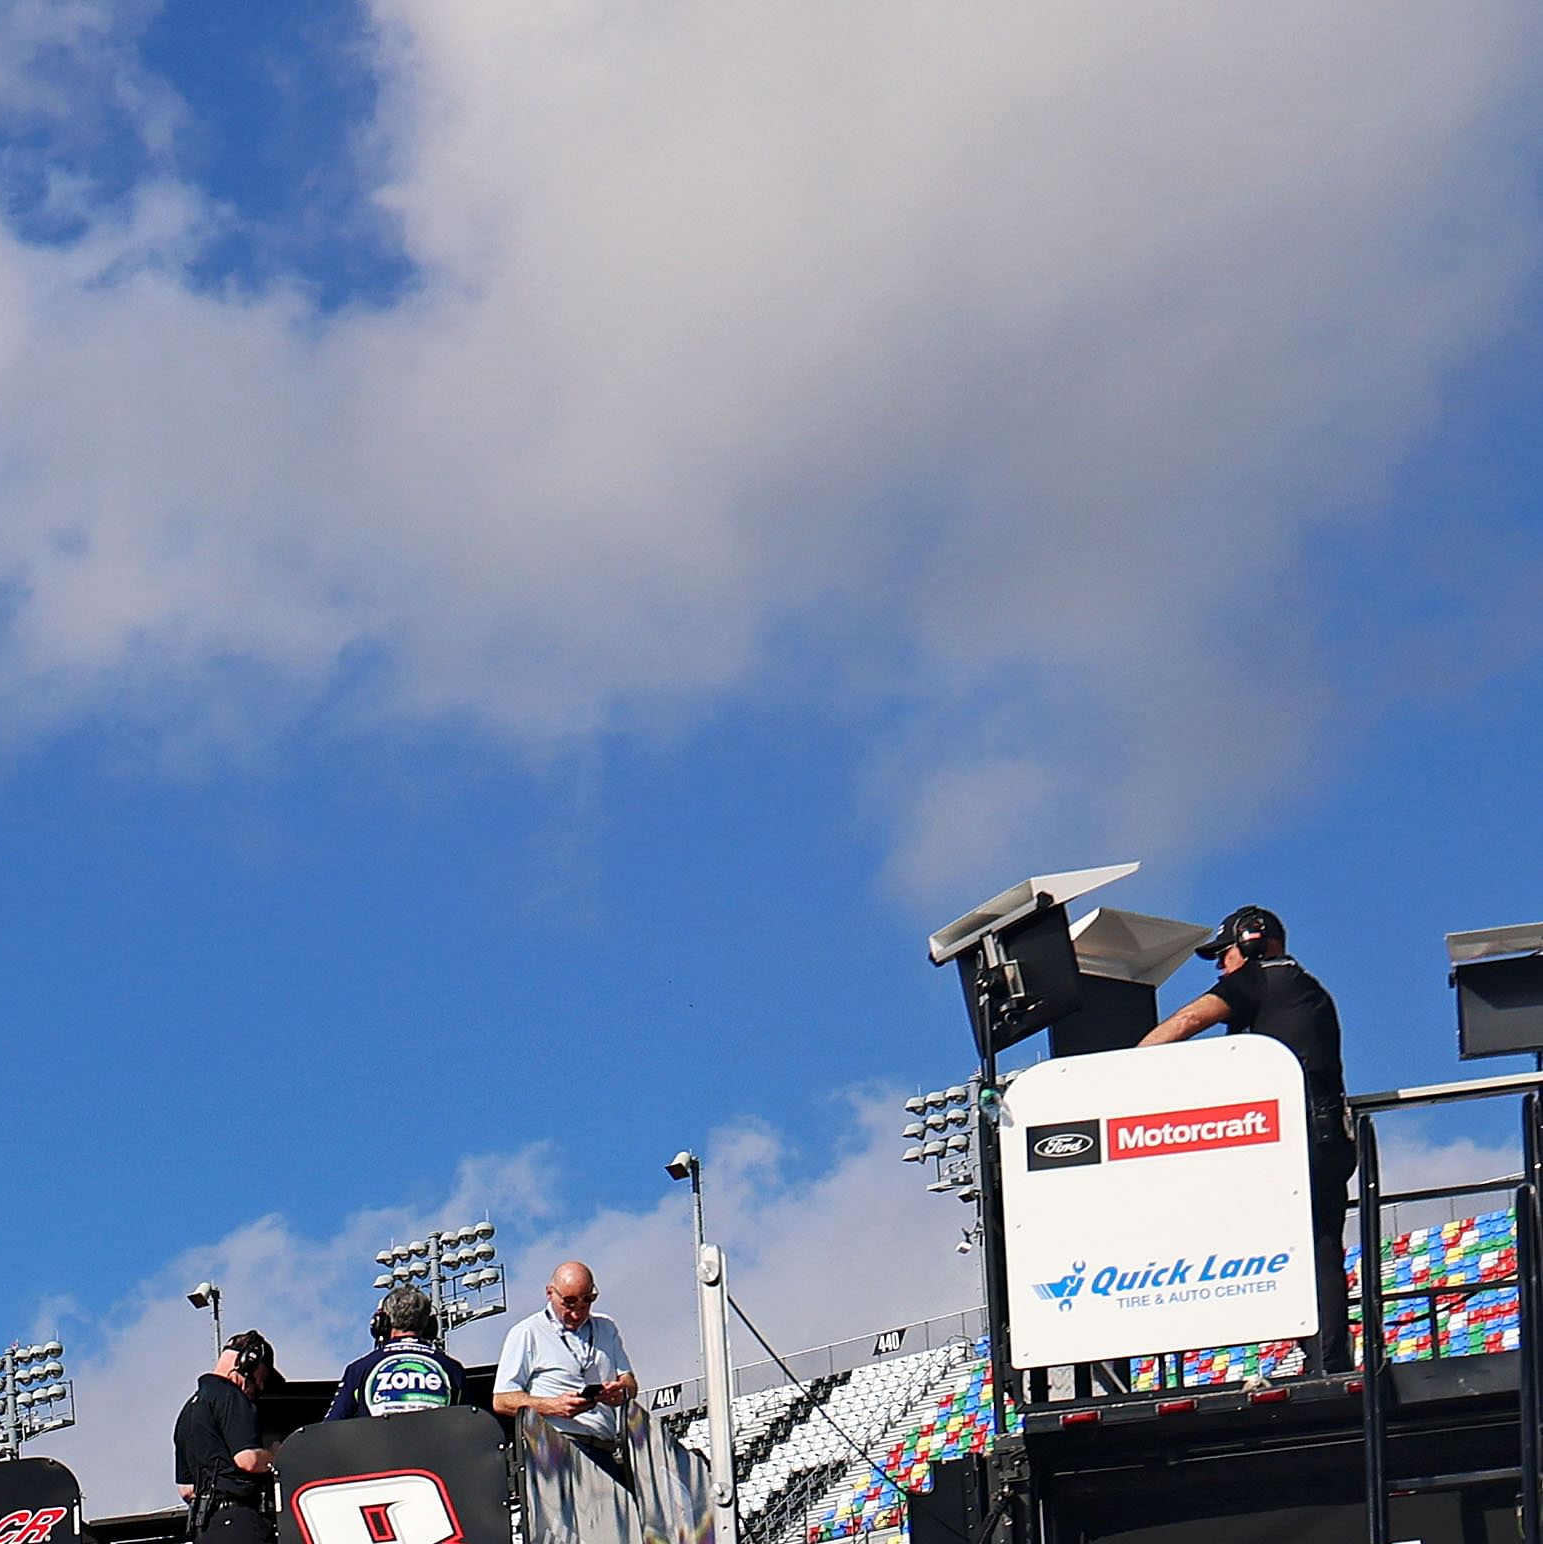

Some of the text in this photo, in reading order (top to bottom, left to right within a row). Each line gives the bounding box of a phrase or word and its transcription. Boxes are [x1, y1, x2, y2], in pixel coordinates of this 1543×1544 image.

[1117, 1110, 1268, 1151] Motorcraft
[1090, 1250, 1290, 1297] Quick Lane
[1116, 1279, 1277, 1310] TIRE & AUTO CENTER
[878, 1331, 900, 1353] 440
[376, 1371, 443, 1392] zone
